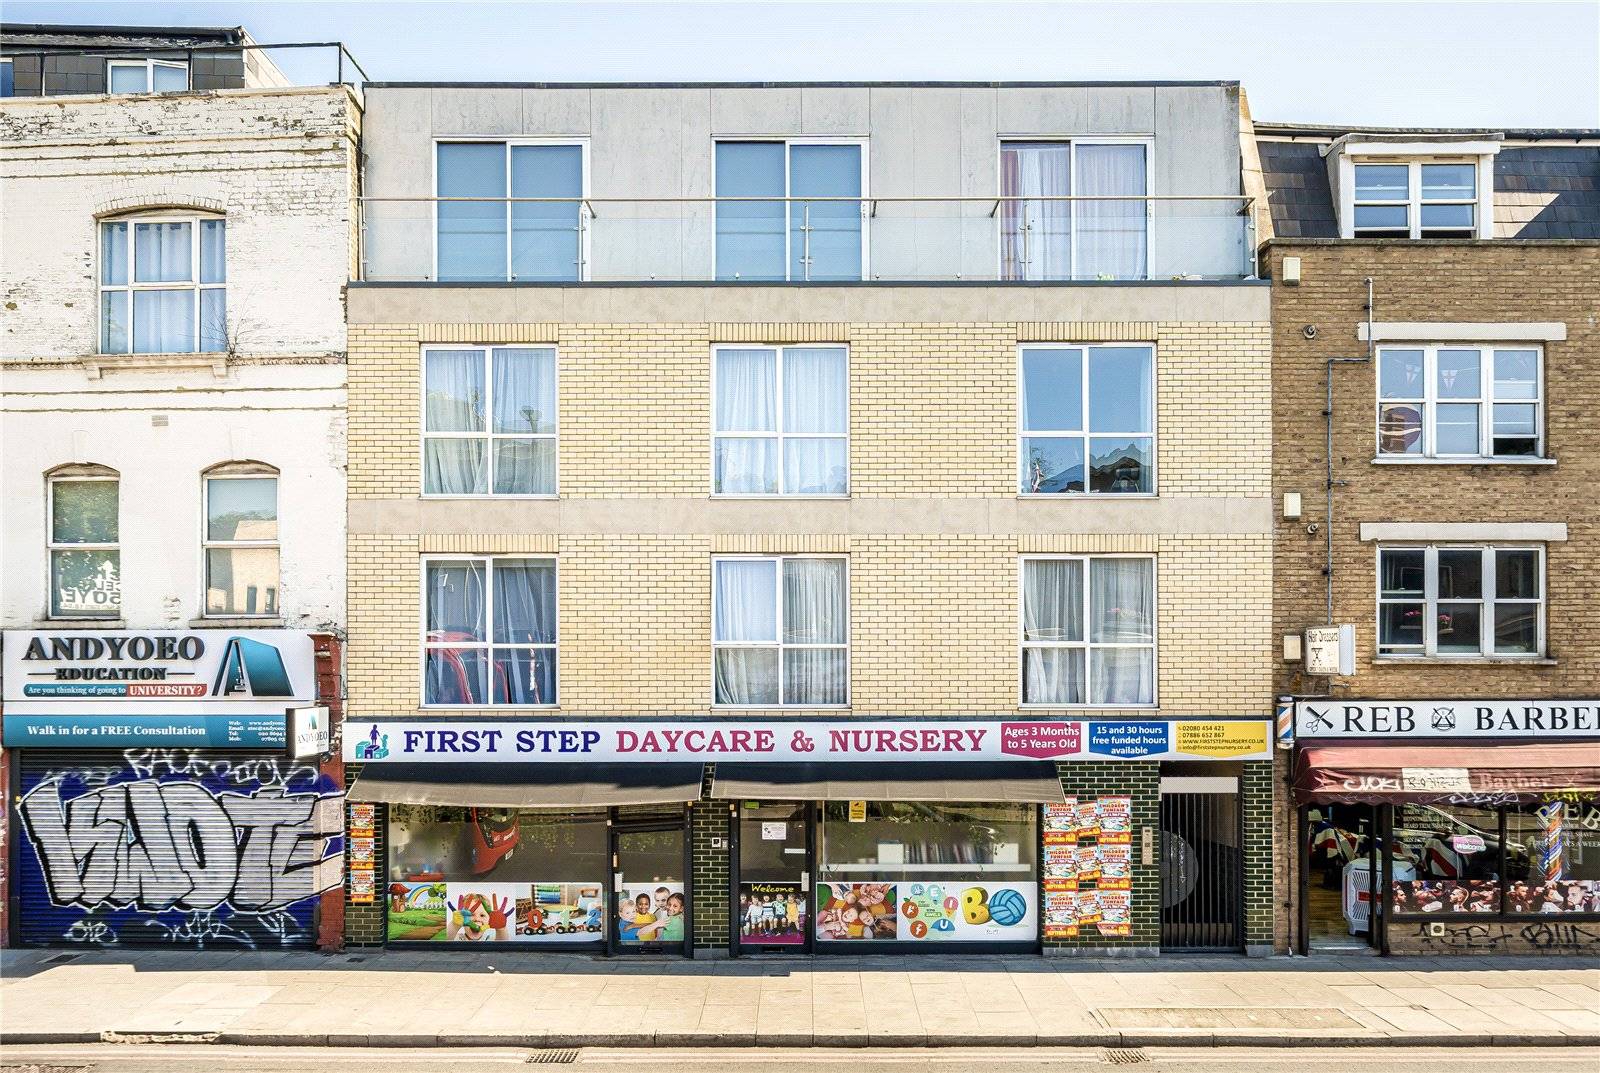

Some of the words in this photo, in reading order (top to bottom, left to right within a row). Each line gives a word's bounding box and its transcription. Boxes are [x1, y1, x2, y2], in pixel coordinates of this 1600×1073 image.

[21, 636, 205, 661] ANDYOEO
[55, 667, 168, 681] EDUCATION
[27, 686, 41, 694] Are
[41, 687, 55, 696] you
[56, 685, 87, 696] thinking
[88, 685, 96, 694] of
[96, 686, 114, 696] going
[115, 686, 127, 694] to
[129, 685, 203, 696] UNIVERSITY?
[1342, 706, 1416, 732] REB
[27, 725, 56, 735] Walk
[58, 725, 70, 735] in
[72, 725, 90, 735] for
[91, 727, 98, 735] a
[100, 725, 132, 735] FREE
[133, 725, 206, 735] Consultation
[1004, 726, 1029, 738] Ages
[1031, 726, 1039, 736] 3
[1040, 726, 1080, 736] Months
[1096, 726, 1107, 734] 15
[1109, 726, 1125, 734] and
[1126, 726, 1137, 734] 30
[1138, 726, 1163, 734] hours
[403, 730, 503, 752] FIRST
[516, 730, 600, 752] STEP
[616, 730, 775, 752] DAYCARE
[790, 730, 815, 753] &
[829, 730, 987, 752] NURSERY
[1007, 740, 1019, 749] to
[1020, 739, 1027, 748] 5
[1029, 739, 1057, 749] Years
[1058, 739, 1077, 749] Old
[1092, 736, 1110, 744] free
[1111, 736, 1141, 744] funded
[1142, 736, 1167, 744] hours
[1111, 746, 1148, 755] available
[1479, 772, 1552, 789] Barber
[751, 883, 794, 893] Welcome
